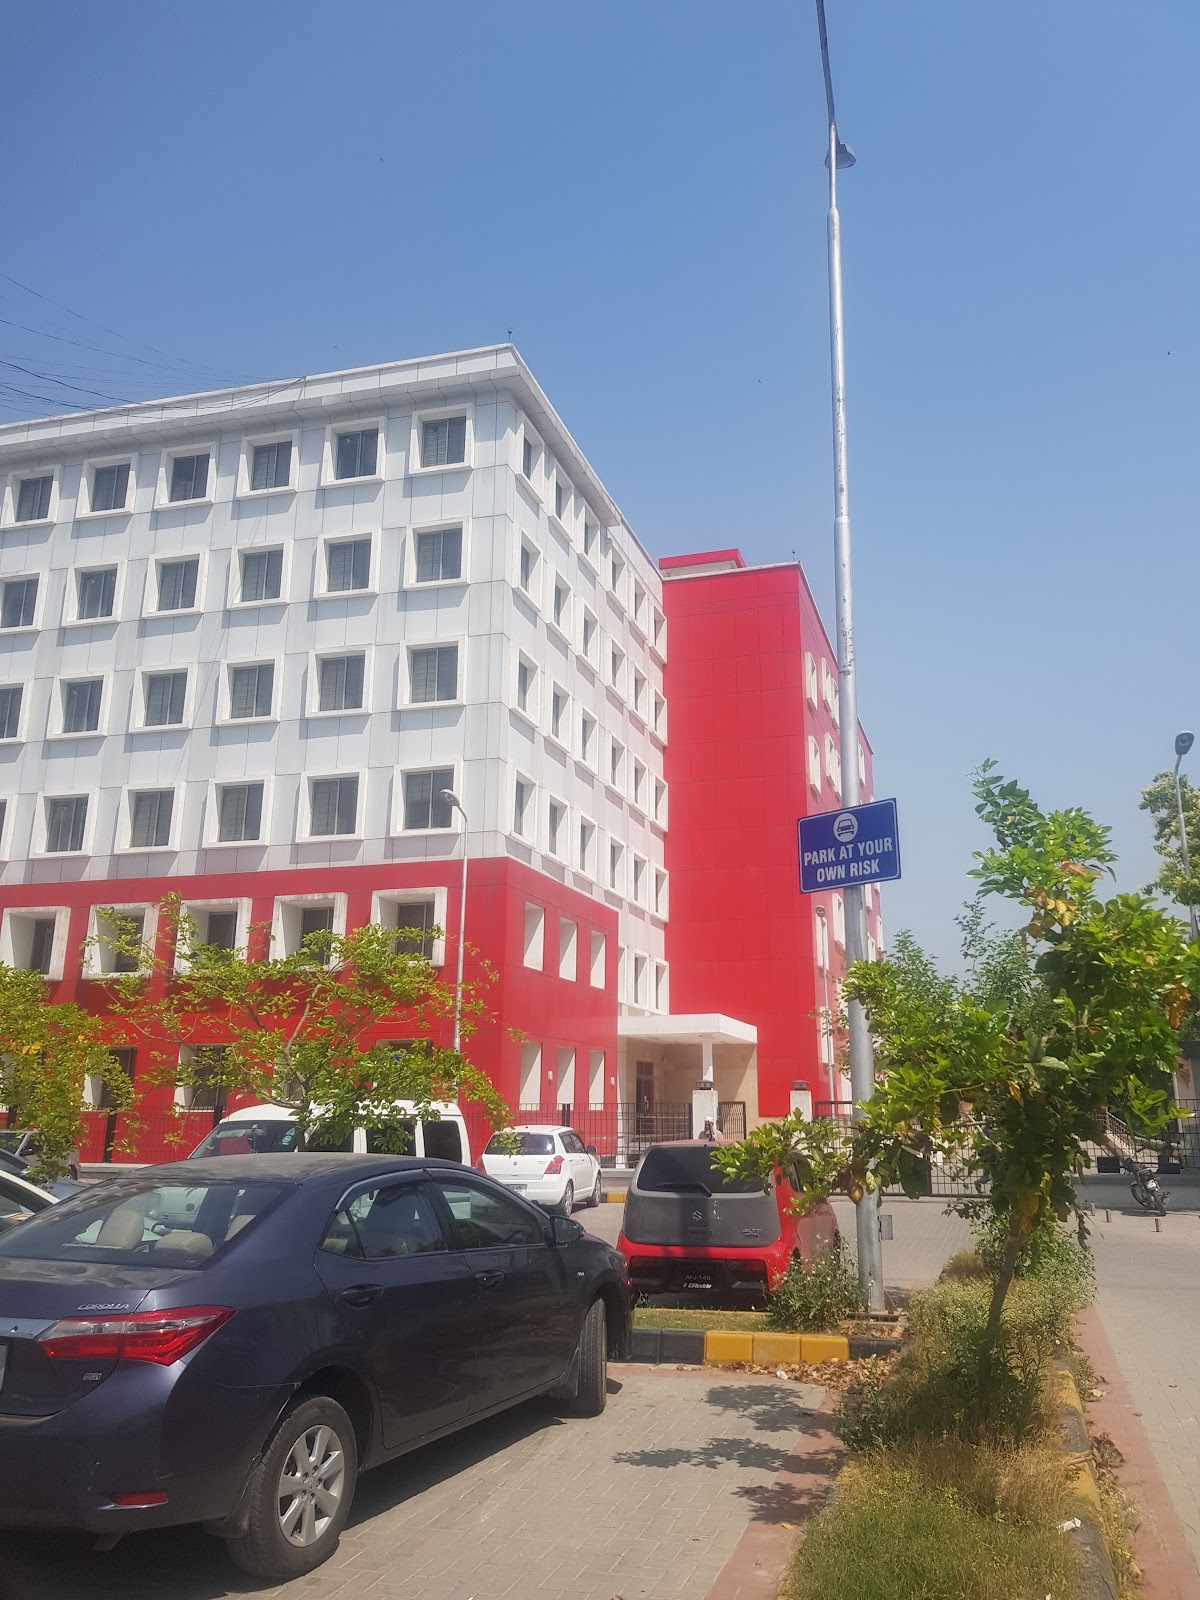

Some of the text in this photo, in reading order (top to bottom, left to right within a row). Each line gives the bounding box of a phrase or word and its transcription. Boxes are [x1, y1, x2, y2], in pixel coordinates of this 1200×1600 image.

[804, 837, 893, 866] PARK AT YOUR
[816, 858, 880, 883] OWN RISK
[77, 1303, 130, 1311] COROLLA
